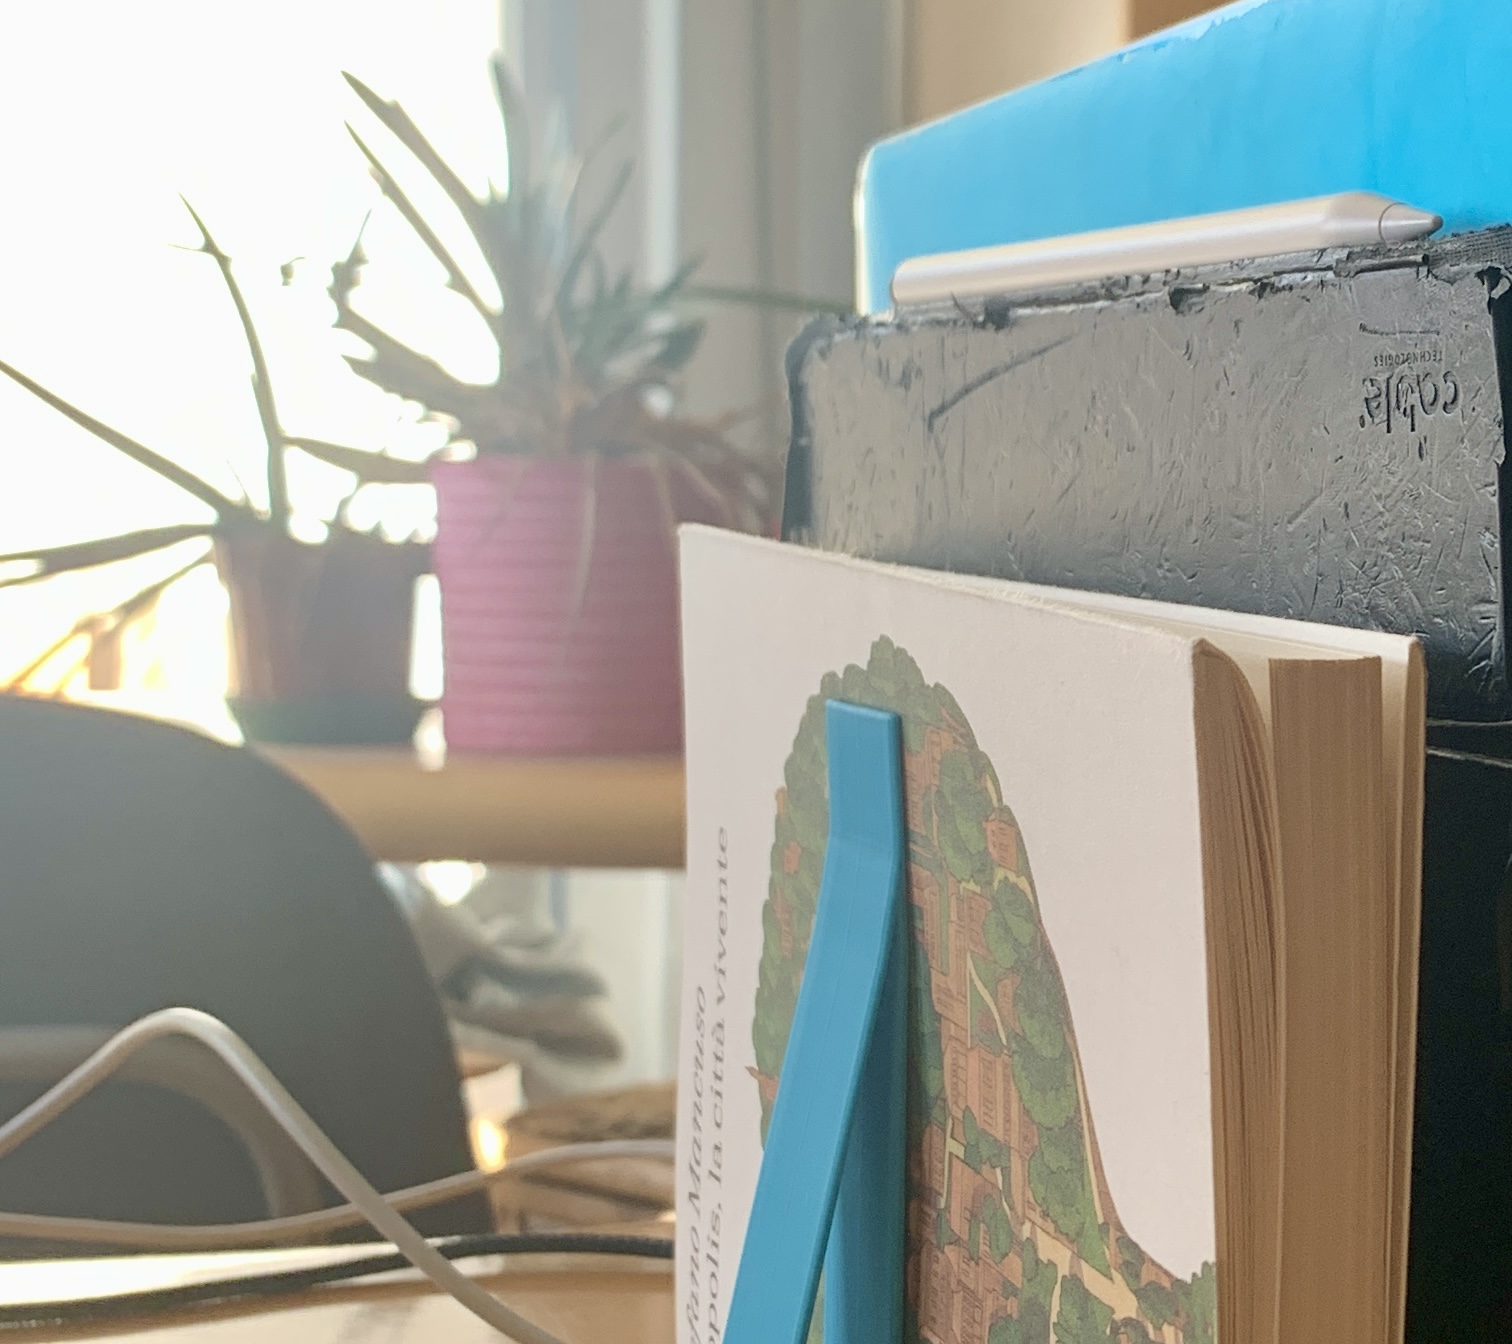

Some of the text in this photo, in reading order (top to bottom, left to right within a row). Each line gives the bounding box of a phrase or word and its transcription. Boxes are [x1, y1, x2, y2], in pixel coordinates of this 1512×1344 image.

[714, 825, 728, 1006] vivente
[688, 984, 706, 1220] Mancuso
[710, 1017, 726, 1131] città
[707, 1140, 723, 1188] la
